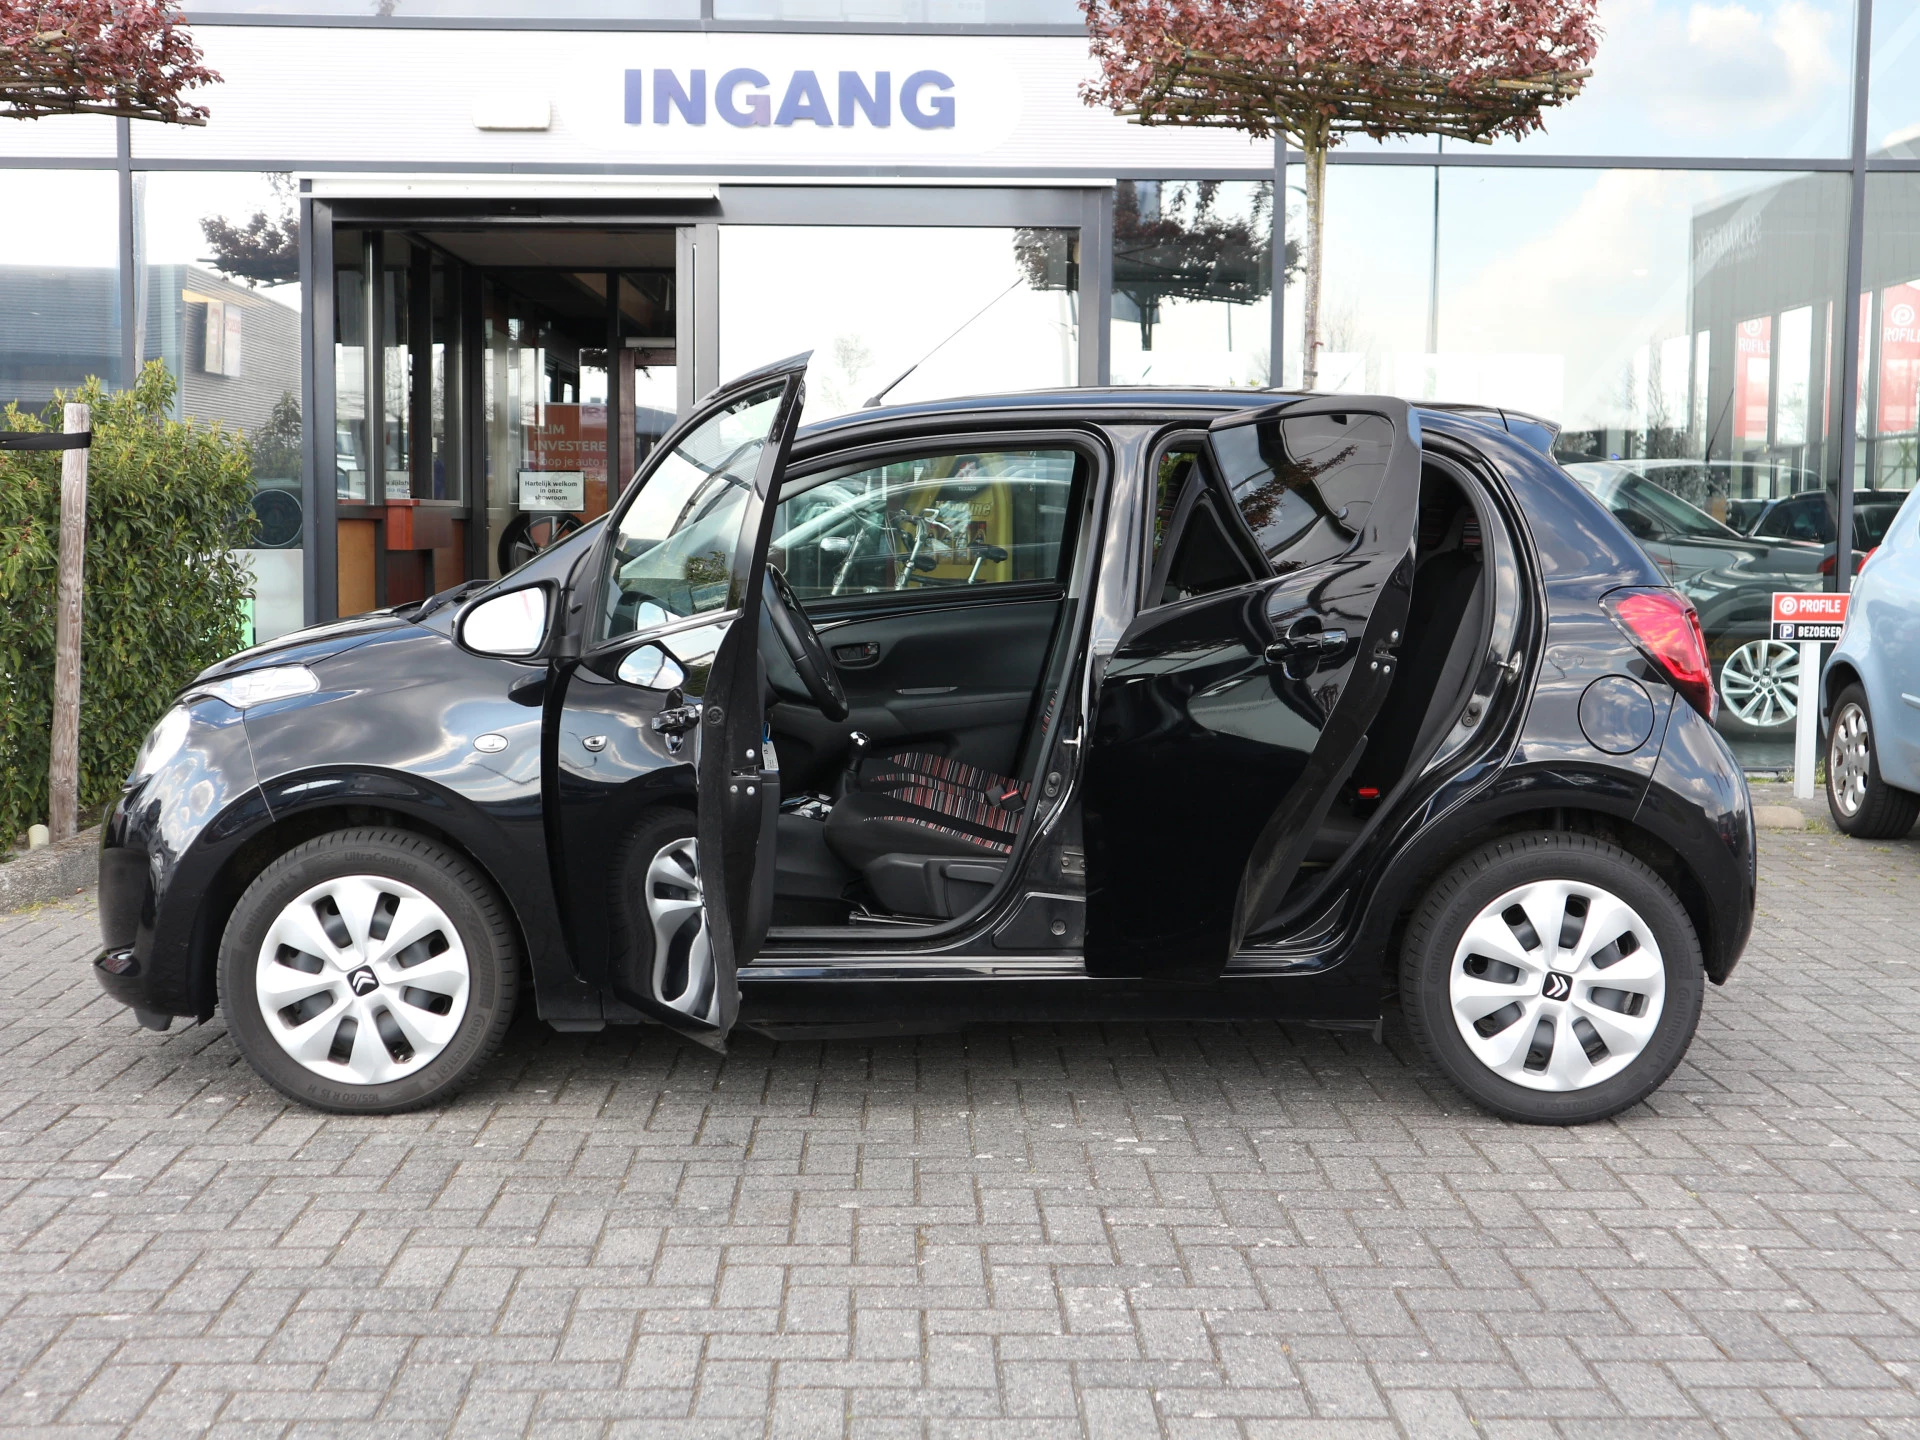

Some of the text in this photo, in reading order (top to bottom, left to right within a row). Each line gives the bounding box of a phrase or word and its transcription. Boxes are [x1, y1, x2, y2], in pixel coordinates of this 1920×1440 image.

[624, 67, 955, 130] INGANG
[1884, 327, 1920, 343] ROFIL
[1738, 336, 1770, 353] ROFILE
[533, 424, 565, 435] SLIM
[533, 440, 607, 451] INVESTERE
[564, 456, 573, 468] je
[576, 458, 599, 466] auto
[525, 480, 551, 488] Hartelijk
[1799, 599, 1841, 613] PROFILE
[1798, 626, 1842, 638] BEZOEKER
